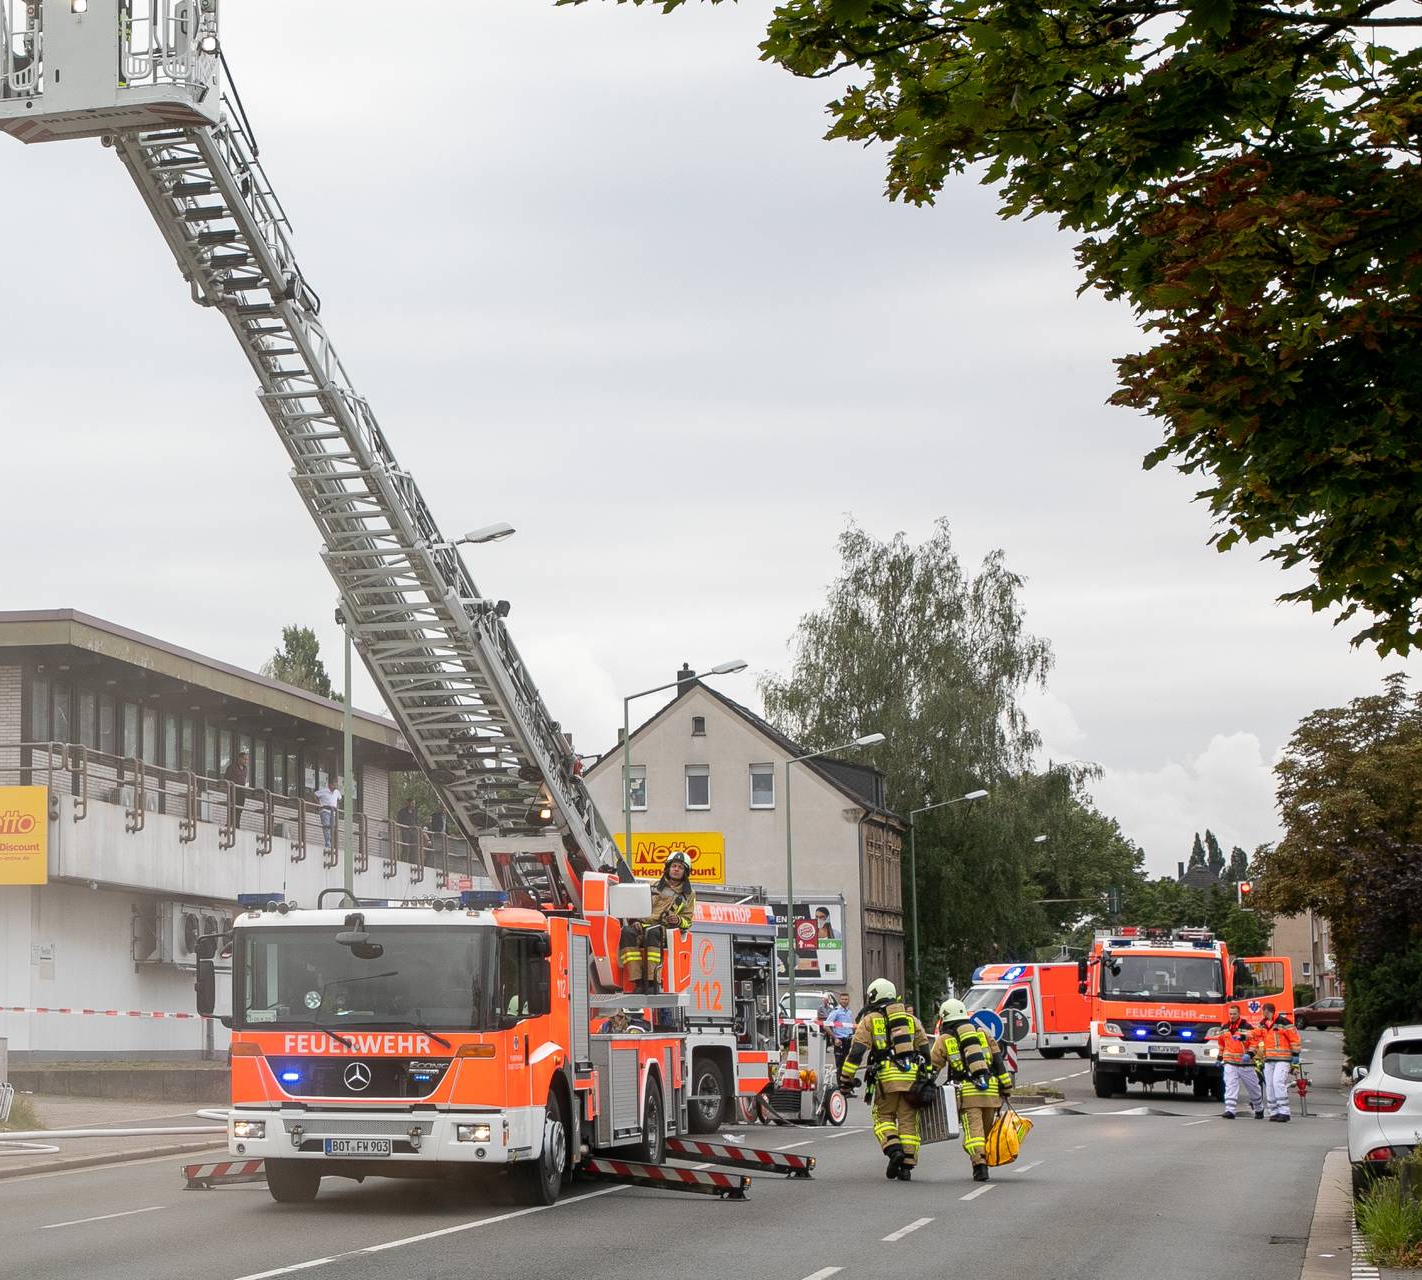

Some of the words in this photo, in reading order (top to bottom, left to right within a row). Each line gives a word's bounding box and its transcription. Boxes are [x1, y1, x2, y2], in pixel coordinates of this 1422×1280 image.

[41, 110, 143, 124] MAGIRUS
[710, 906, 751, 922] BOTTROP
[557, 980, 566, 998] 112
[693, 980, 723, 1011] 112
[1125, 1008, 1197, 1019] FEUERWEHR
[284, 1035, 431, 1054] FEUERWEHR
[333, 1141, 350, 1151] BOT
[357, 1142, 368, 1151] FW
[371, 1142, 388, 1152] 903
